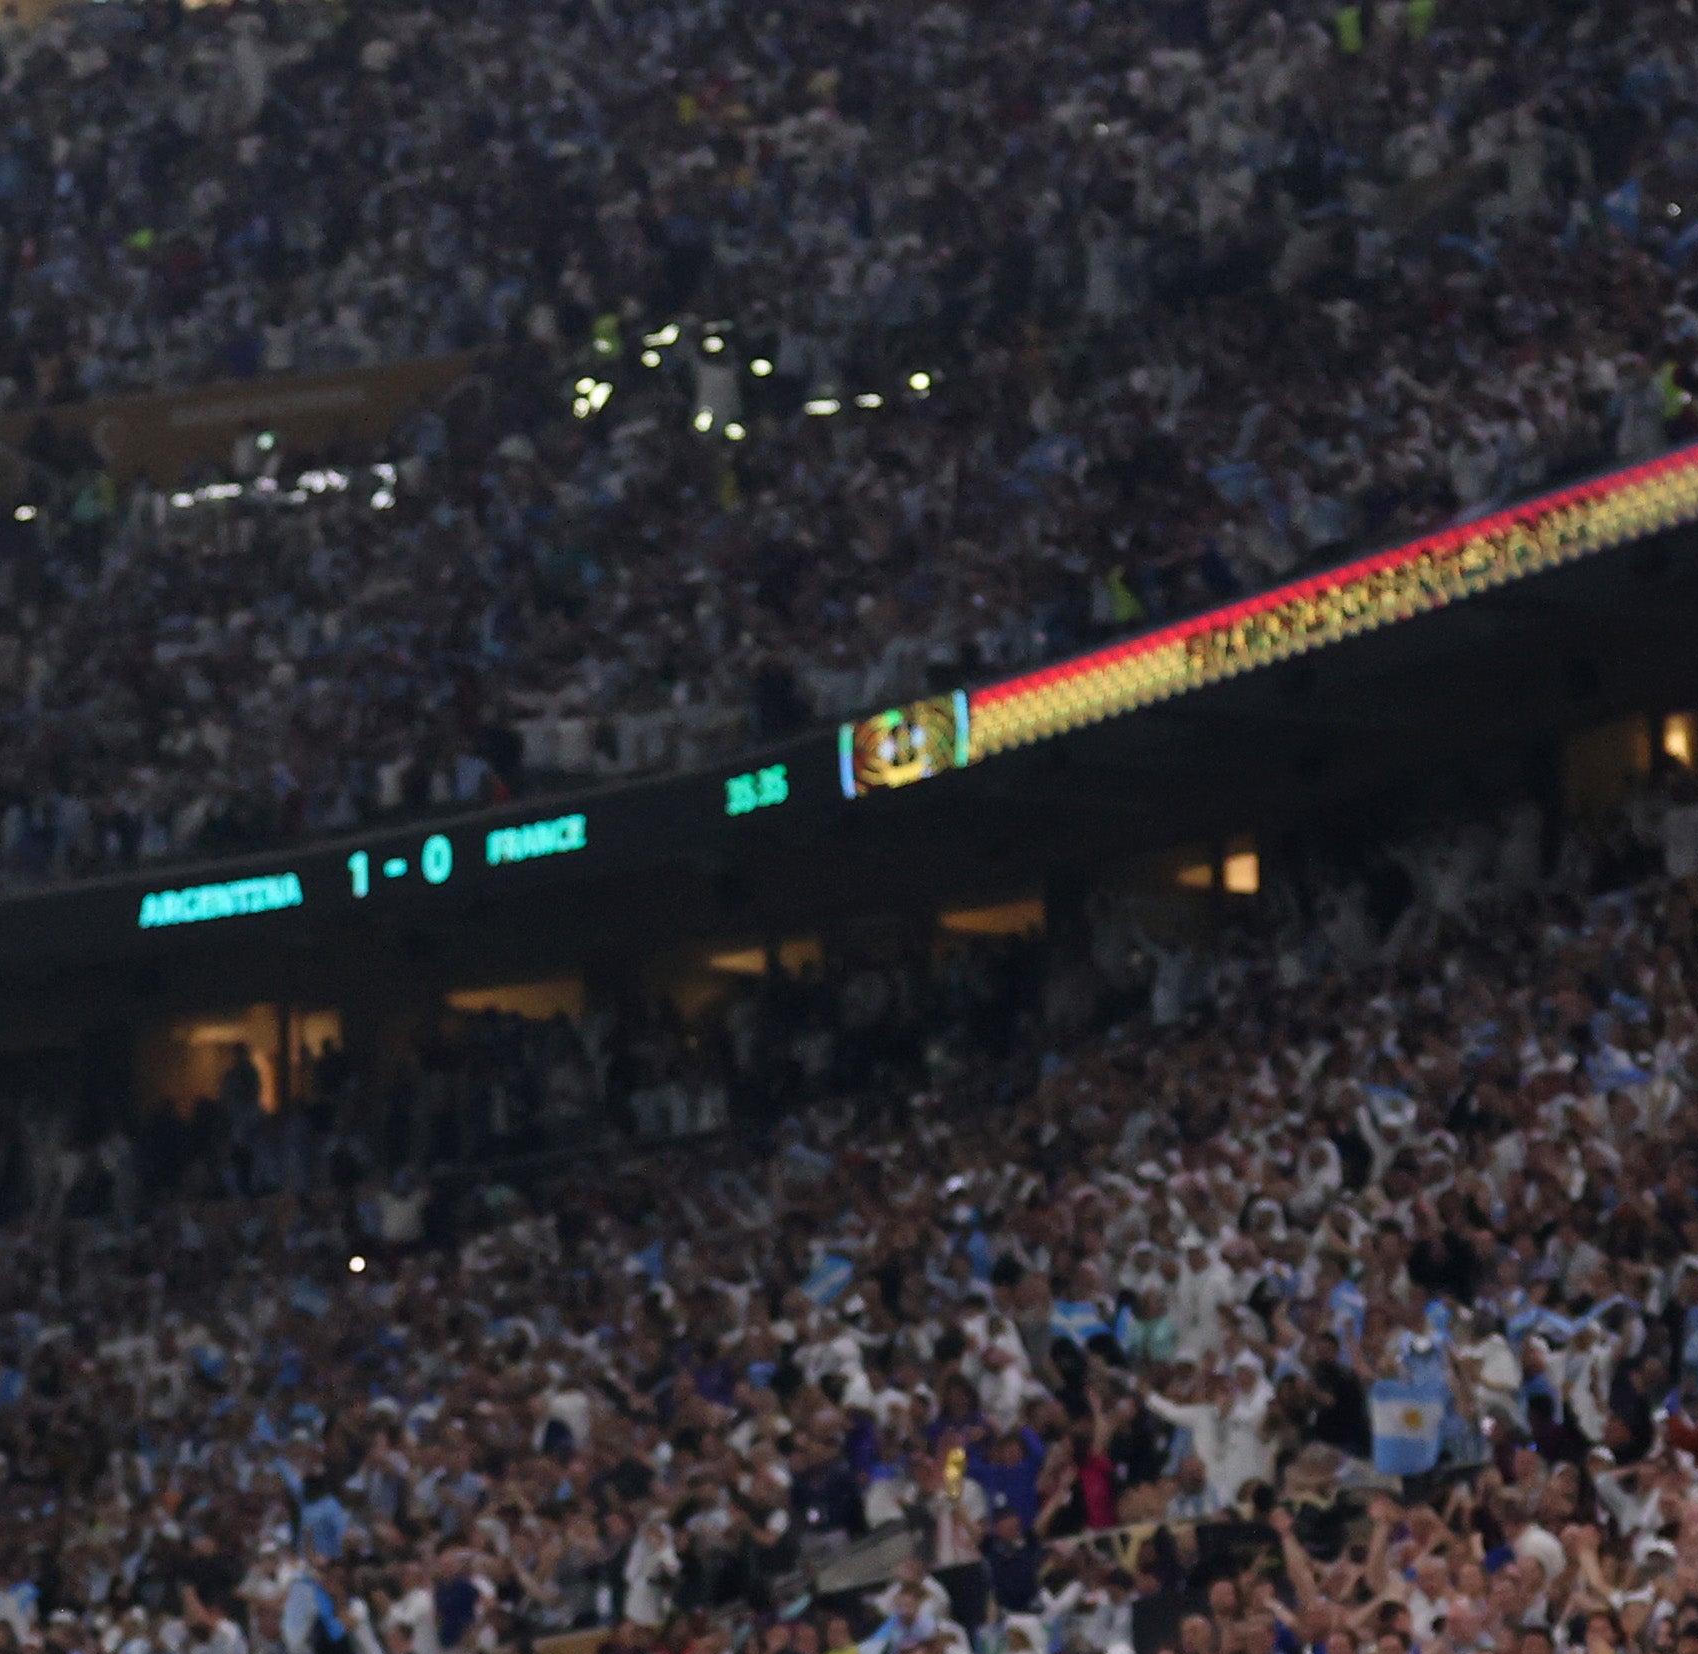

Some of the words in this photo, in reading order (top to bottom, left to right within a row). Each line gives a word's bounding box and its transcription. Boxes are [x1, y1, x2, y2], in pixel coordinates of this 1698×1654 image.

[138, 871, 304, 929] ARGENTINA
[347, 850, 370, 898] 1
[421, 834, 452, 884] 0
[485, 813, 588, 866] FRANCE
